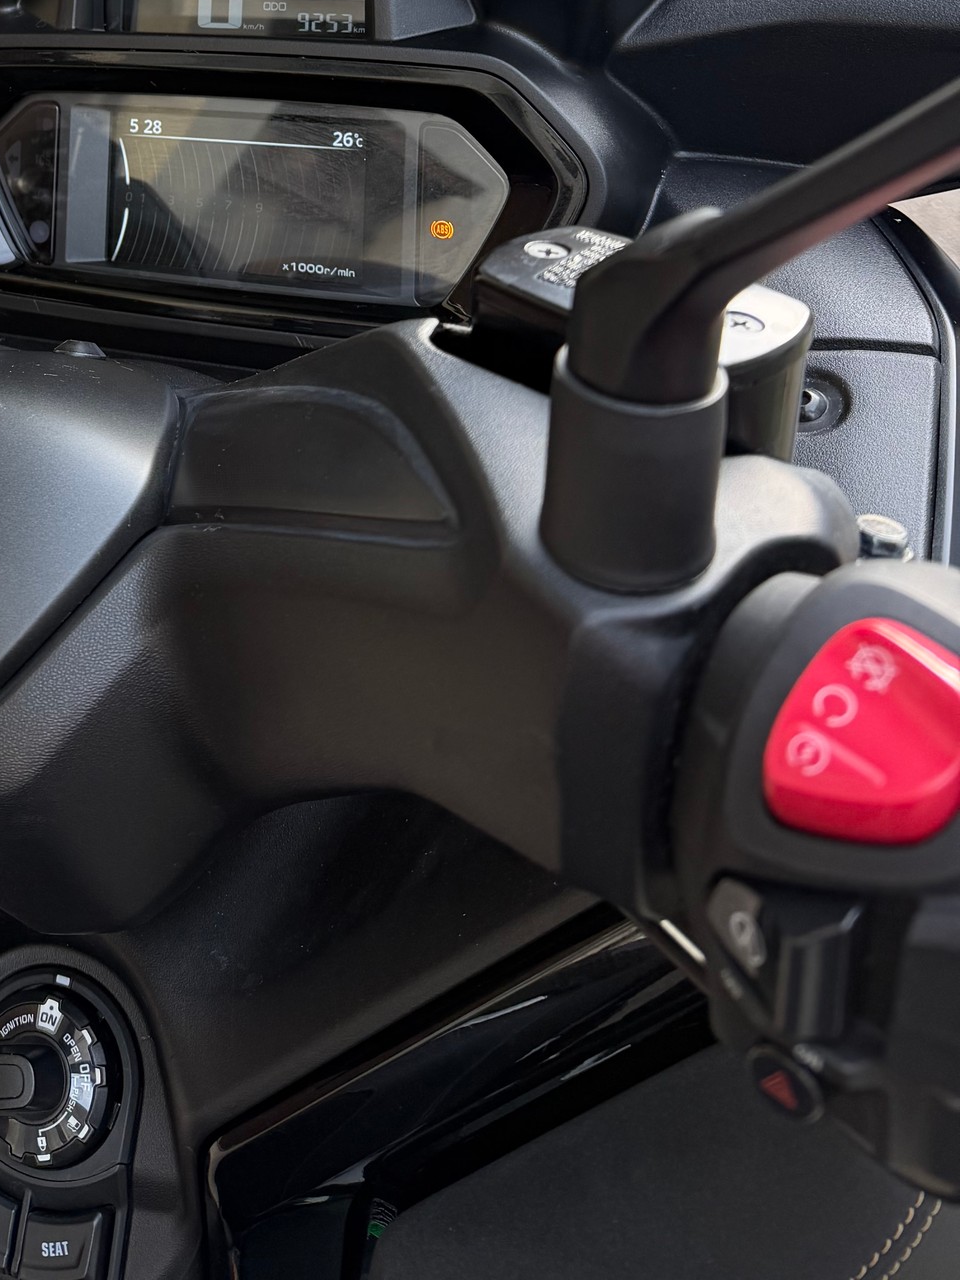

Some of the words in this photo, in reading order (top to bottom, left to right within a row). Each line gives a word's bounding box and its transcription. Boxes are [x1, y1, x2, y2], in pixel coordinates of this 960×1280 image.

[263, 2, 287, 11] ODO
[297, 12, 353, 33] 9253
[196, 197, 204, 207] 5
[225, 200, 232, 210] 7
[255, 202, 263, 213] 9
[435, 224, 449, 235] ABS
[0, 1013, 35, 1038] IGNITION
[40, 1011, 58, 1027] ON
[62, 1032, 82, 1062] OPEN
[79, 1063, 91, 1092] OFF
[66, 1088, 80, 1113] PUSH
[41, 1240, 69, 1257] SEAT
